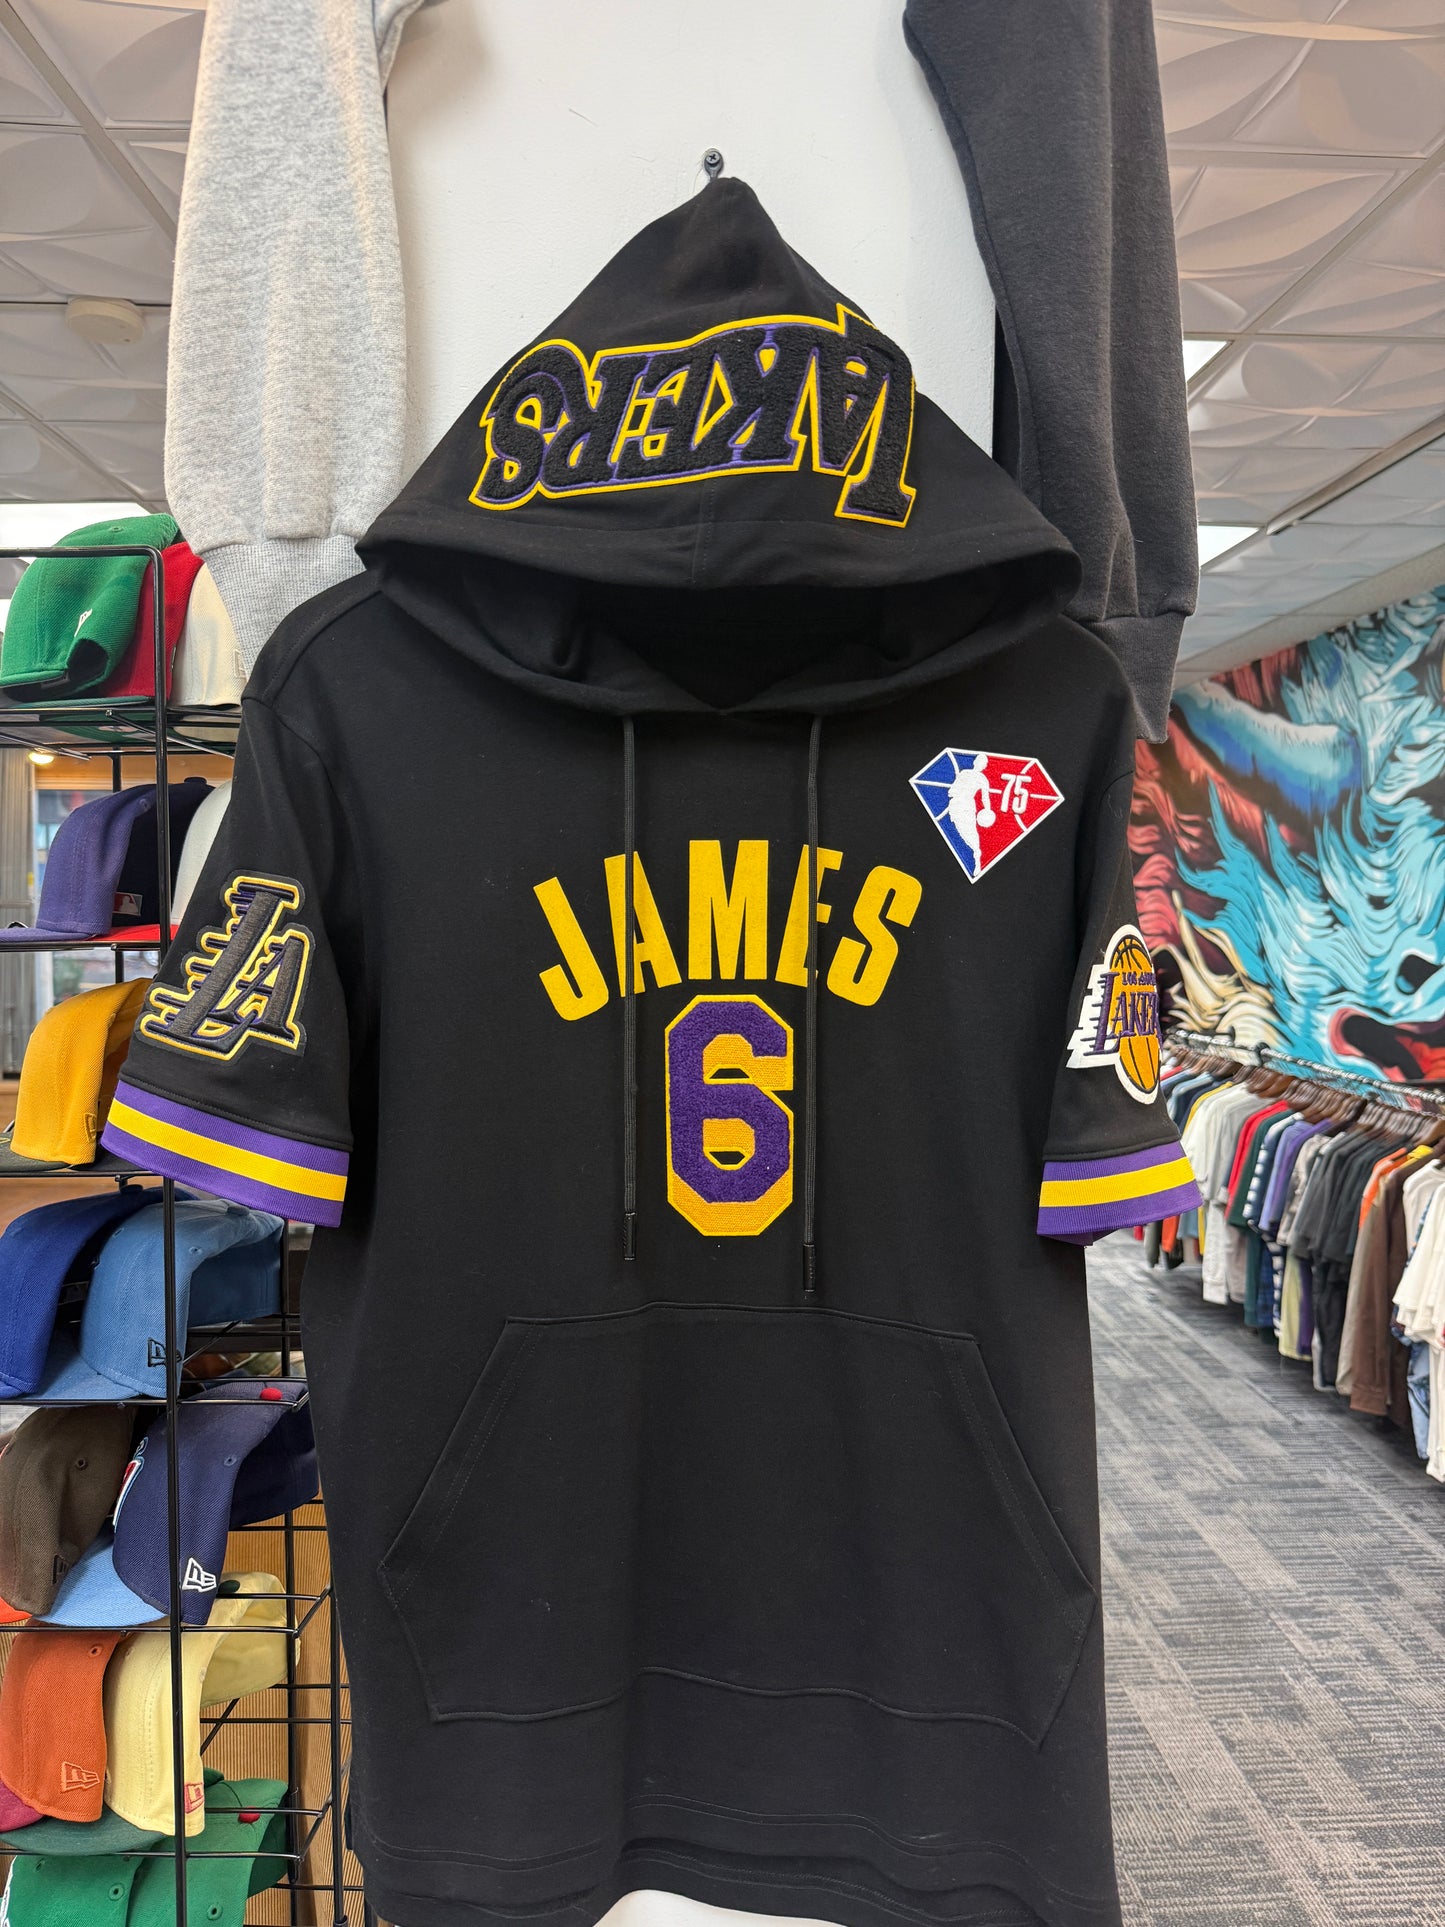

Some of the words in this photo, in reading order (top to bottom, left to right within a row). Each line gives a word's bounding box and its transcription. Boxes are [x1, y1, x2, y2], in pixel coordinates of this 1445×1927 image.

[468, 303, 917, 528] LAKERS
[1000, 773, 1032, 814] 75
[140, 876, 310, 1060] LA
[533, 840, 922, 1021] JAMES
[1080, 972, 1163, 1056] LAKER
[665, 994, 794, 1236] 6
